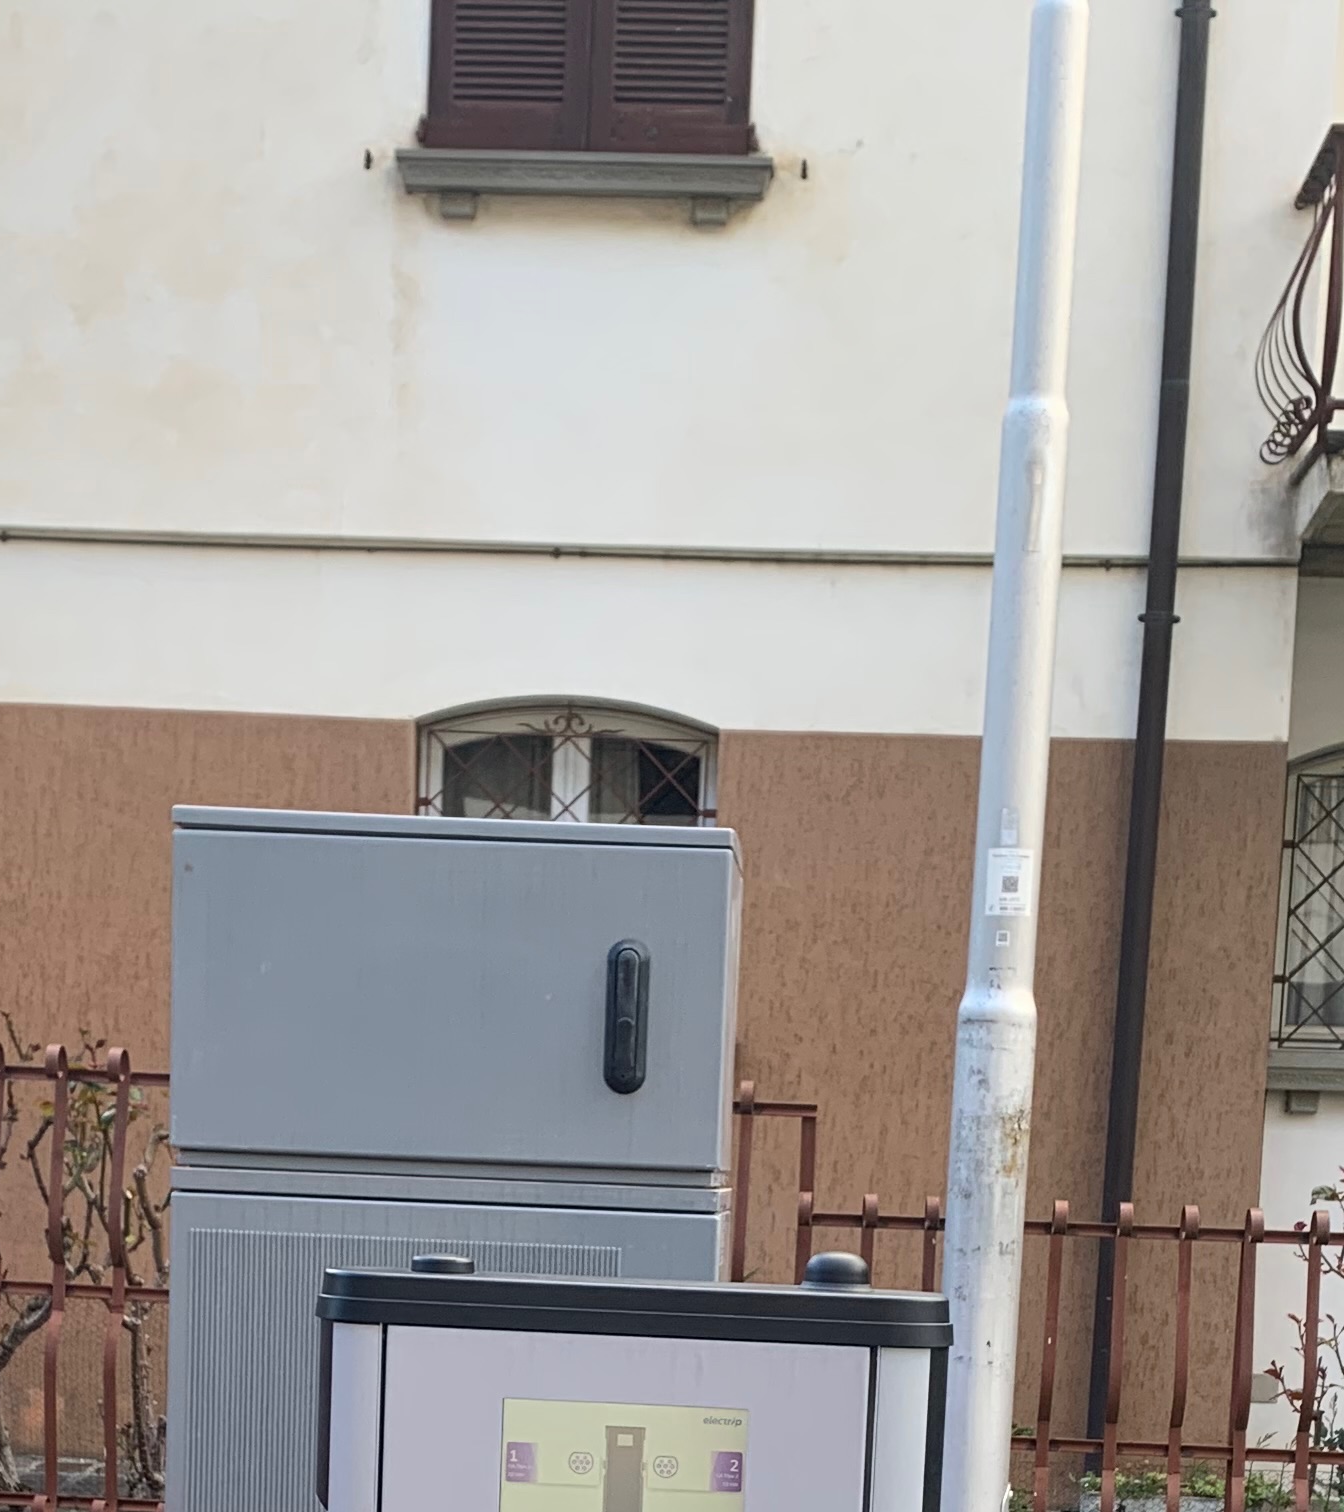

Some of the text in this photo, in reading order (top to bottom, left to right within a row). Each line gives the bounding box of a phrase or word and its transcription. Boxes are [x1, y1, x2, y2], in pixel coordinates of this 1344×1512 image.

[702, 1415, 743, 1427] electrip
[510, 1449, 518, 1462] 1
[729, 1459, 739, 1472] 2
